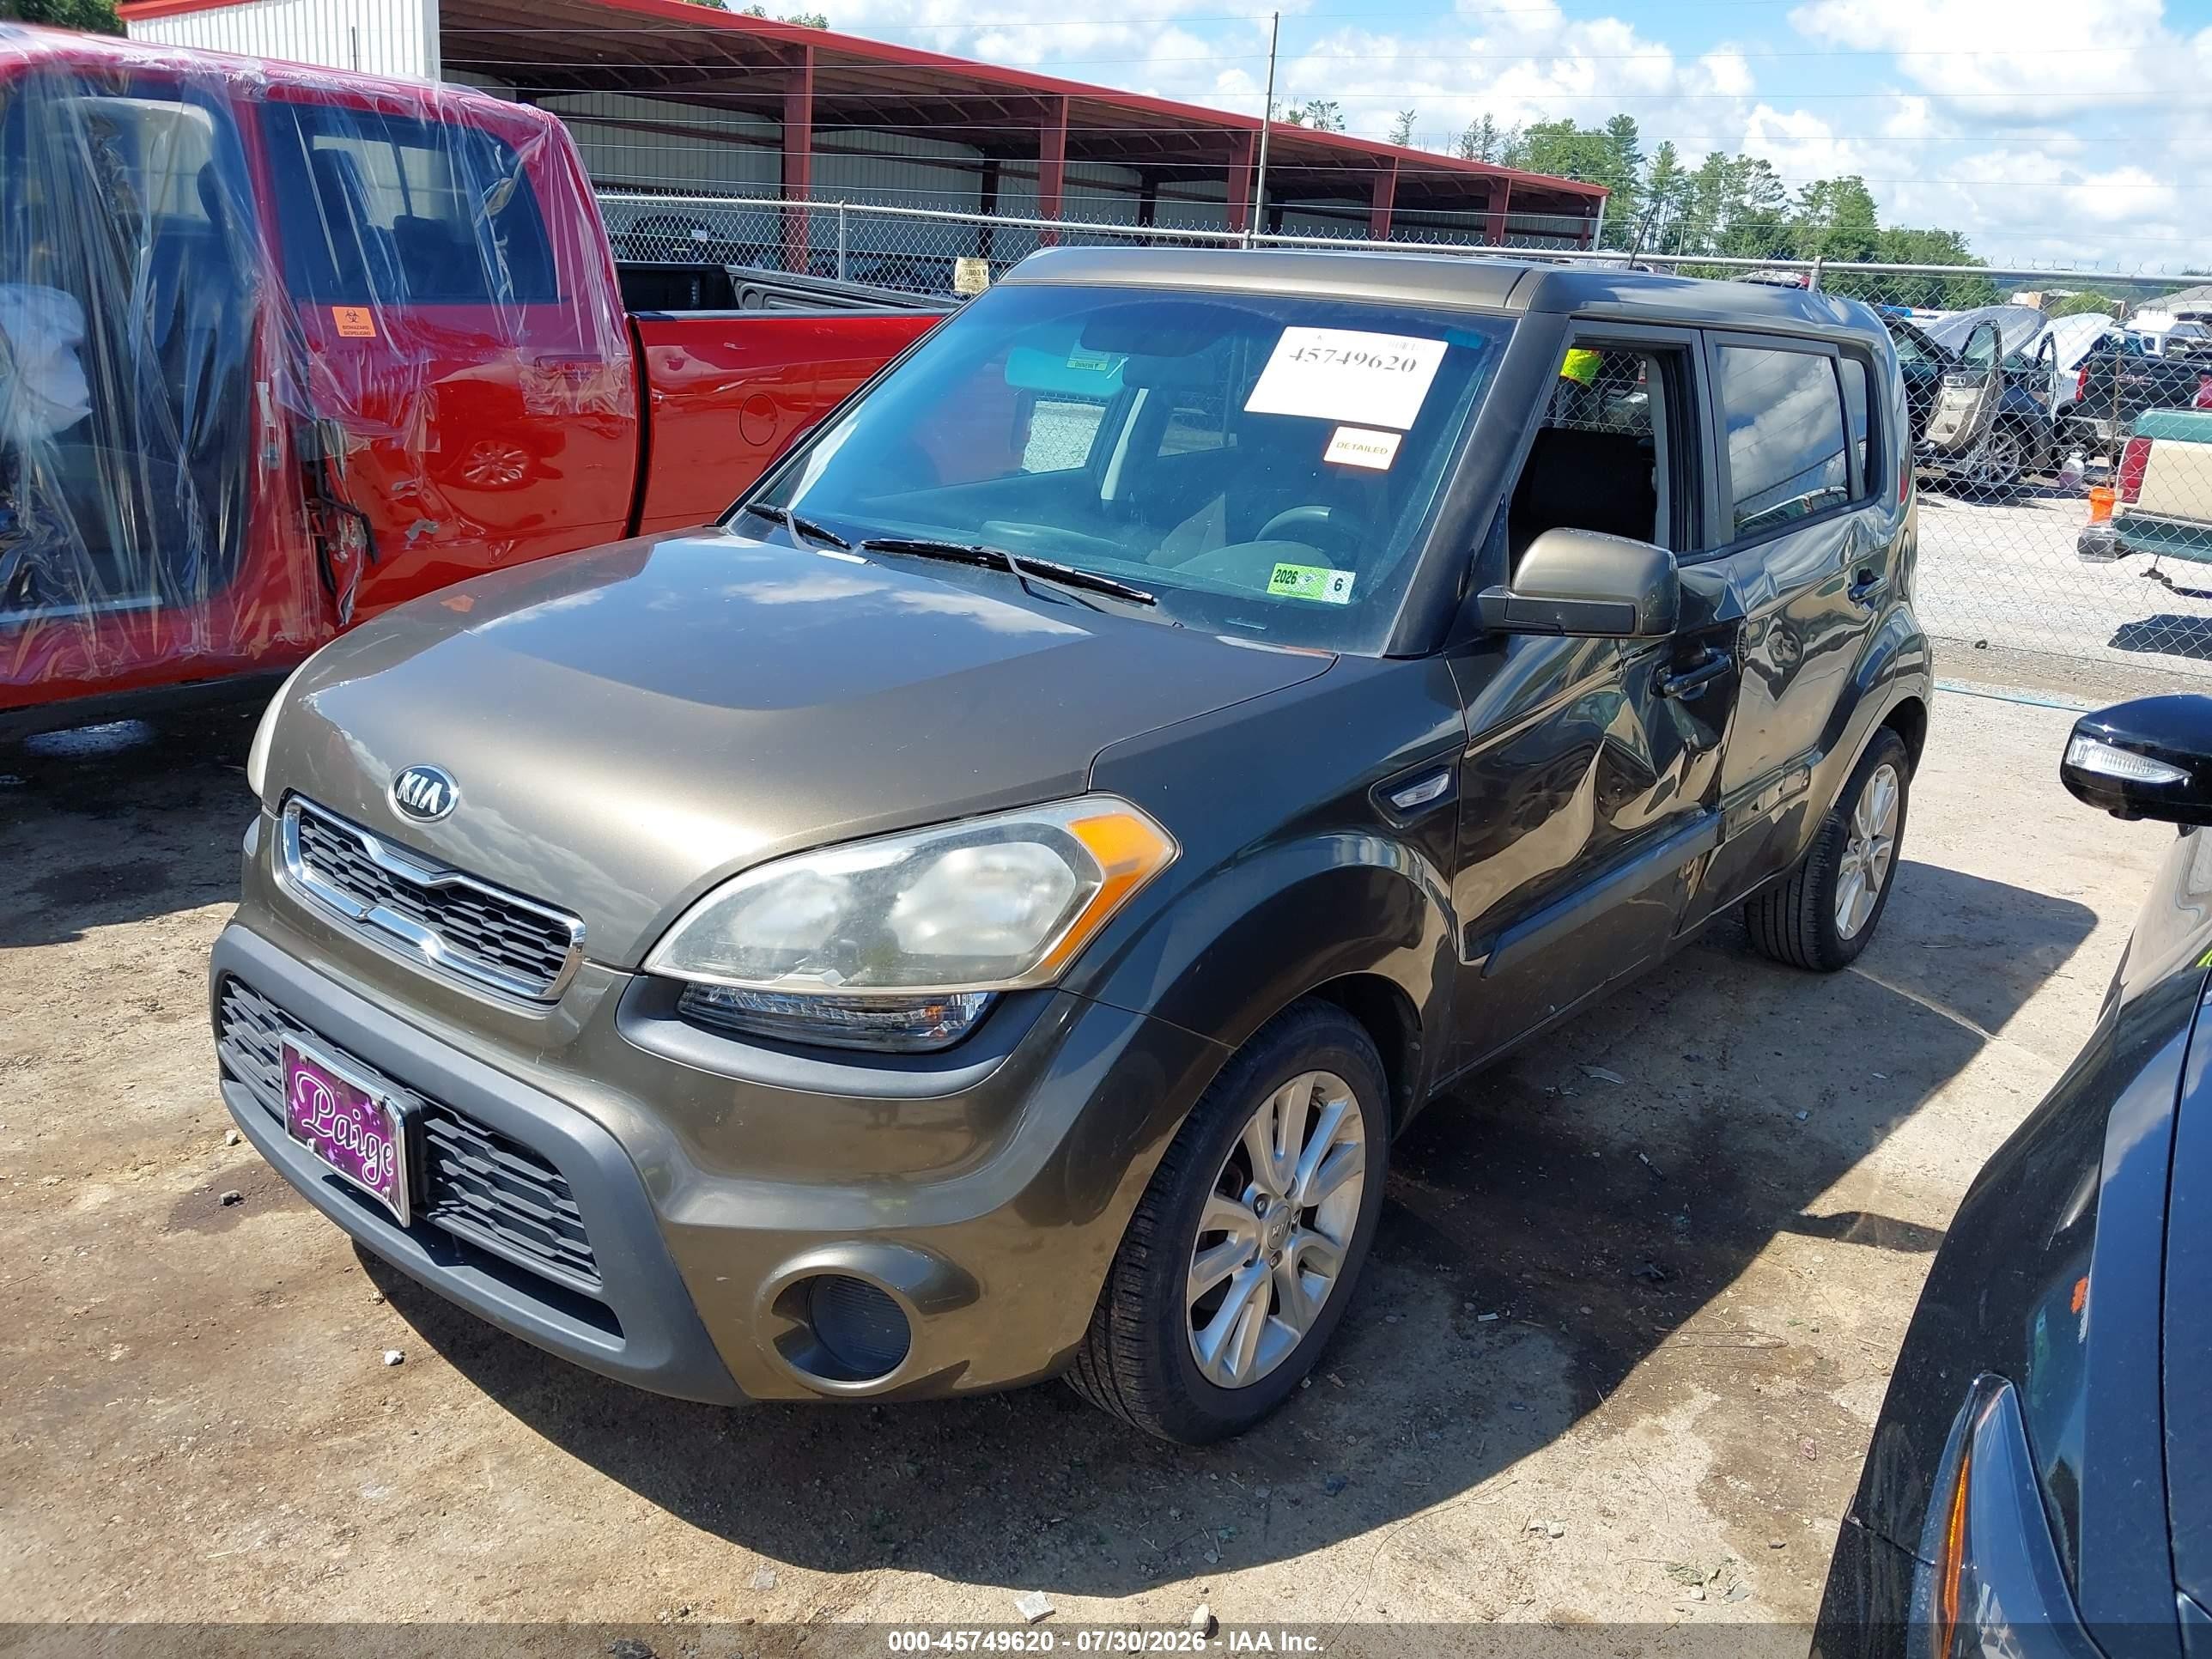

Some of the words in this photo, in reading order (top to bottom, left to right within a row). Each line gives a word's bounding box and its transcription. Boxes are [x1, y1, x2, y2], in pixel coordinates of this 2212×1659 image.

[1289, 346, 1418, 374] 45749620
[1335, 440, 1389, 456] DETAILED
[1273, 568, 1298, 585] 2026
[1334, 577, 1344, 592] 6
[396, 771, 443, 815] KIA
[295, 1070, 394, 1186] Paige
